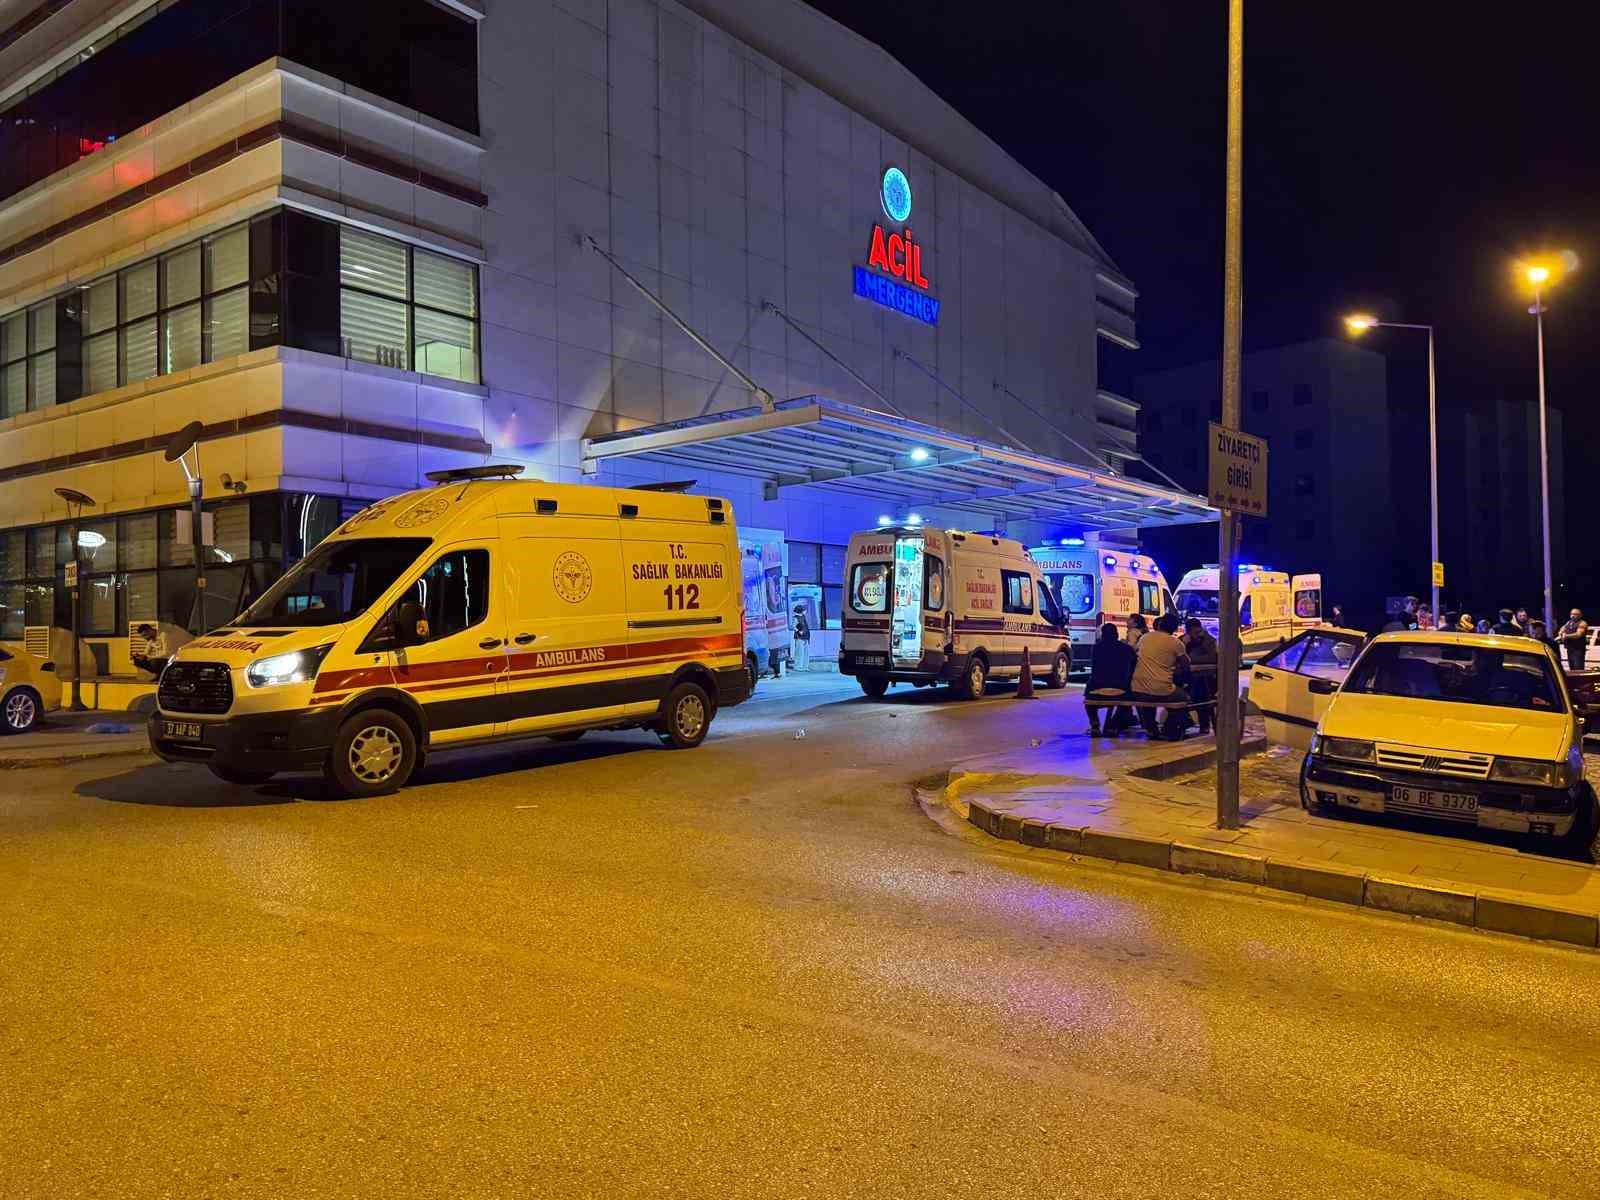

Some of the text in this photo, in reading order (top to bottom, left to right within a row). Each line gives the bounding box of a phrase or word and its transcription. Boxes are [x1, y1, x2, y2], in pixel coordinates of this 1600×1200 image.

[869, 225, 929, 289] ACİL
[1217, 430, 1261, 465] ZİYARETÇİ
[669, 544, 688, 559] T.C.
[632, 561, 723, 580] SAĞLIK BAKANLIĞI
[663, 583, 700, 610] 112
[535, 647, 606, 669] AMBULANS
[1393, 787, 1410, 801] 06
